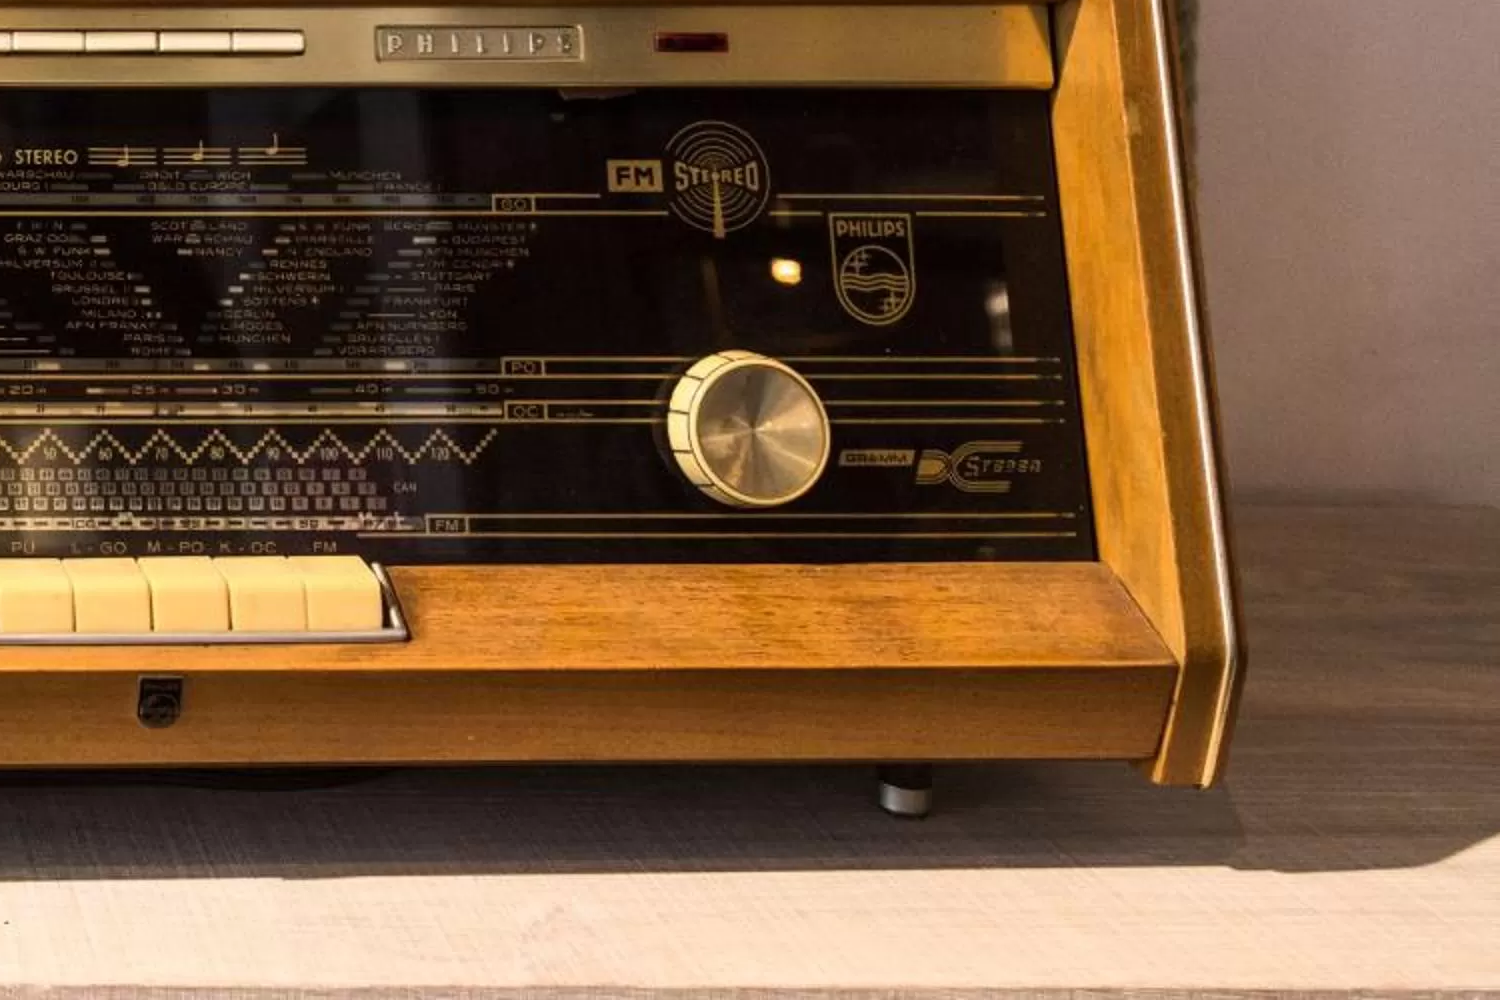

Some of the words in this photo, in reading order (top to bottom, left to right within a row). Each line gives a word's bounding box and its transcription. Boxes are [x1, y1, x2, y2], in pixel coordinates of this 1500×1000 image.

[387, 32, 573, 55] PHILIPS
[15, 149, 79, 165] STEREO
[615, 165, 655, 187] FM
[674, 160, 760, 192] STEREO
[835, 219, 905, 237] PHILIPS
[511, 361, 537, 374] PO
[8, 384, 33, 396] 20
[513, 405, 541, 418] OC
[154, 447, 169, 460] 70
[210, 447, 225, 460] 80
[319, 447, 339, 460] 100
[376, 447, 393, 460] 110
[430, 447, 450, 460] 120
[435, 519, 459, 533] FM
[11, 541, 36, 554] PU
[100, 541, 127, 555] GO
[147, 541, 161, 554] M
[219, 541, 231, 554] K
[313, 541, 338, 554] FM
